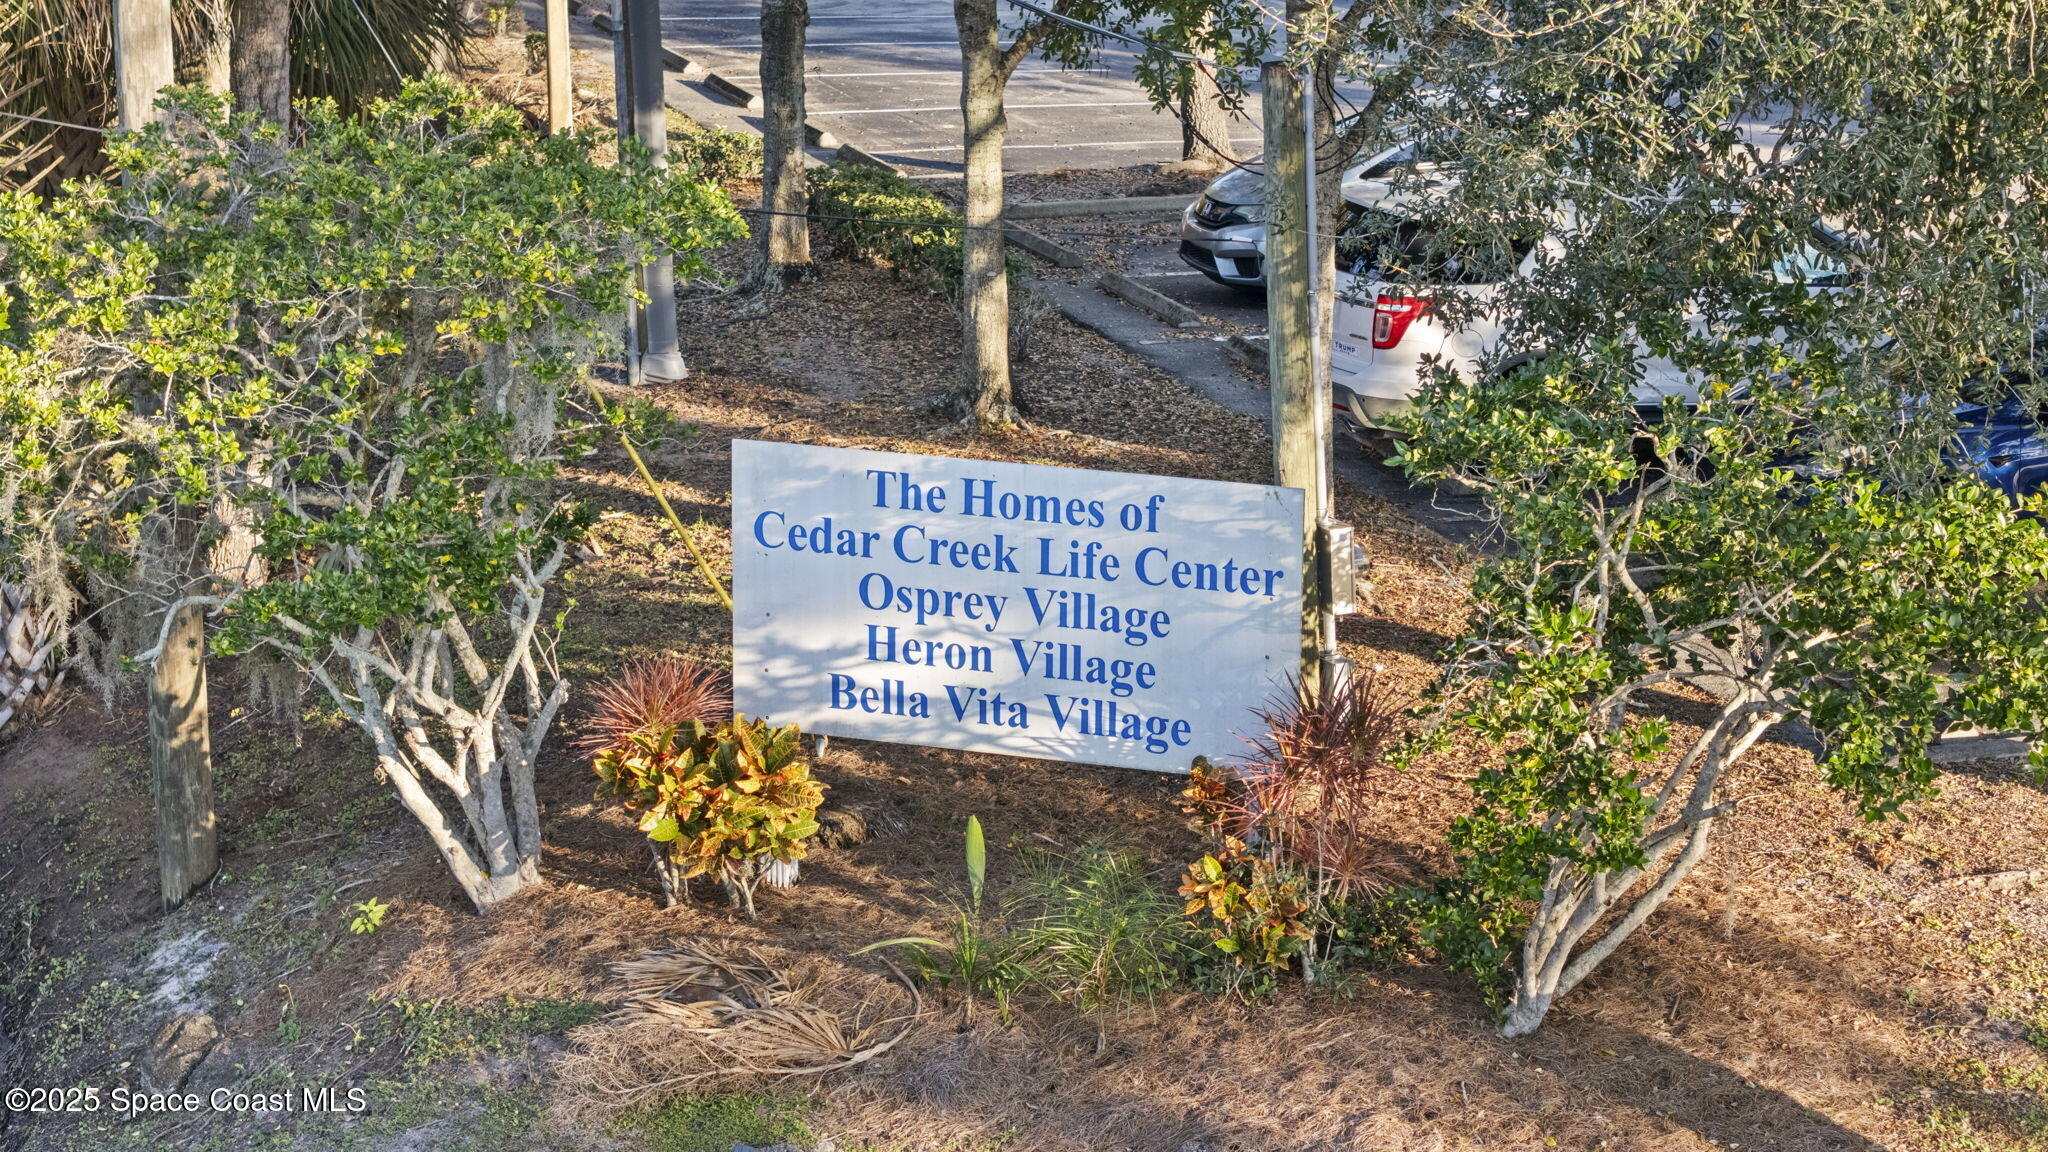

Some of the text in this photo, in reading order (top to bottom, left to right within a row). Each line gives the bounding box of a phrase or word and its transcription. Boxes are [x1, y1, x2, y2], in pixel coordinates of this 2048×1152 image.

[1334, 341, 1356, 353] TRUMP
[866, 469, 1166, 533] The Homes of
[753, 510, 1285, 598] Cedar Creek Life Center
[858, 572, 1172, 647] Osprey Village
[865, 624, 1157, 698] Heron Village
[828, 672, 1192, 755] Bella Vita Village
